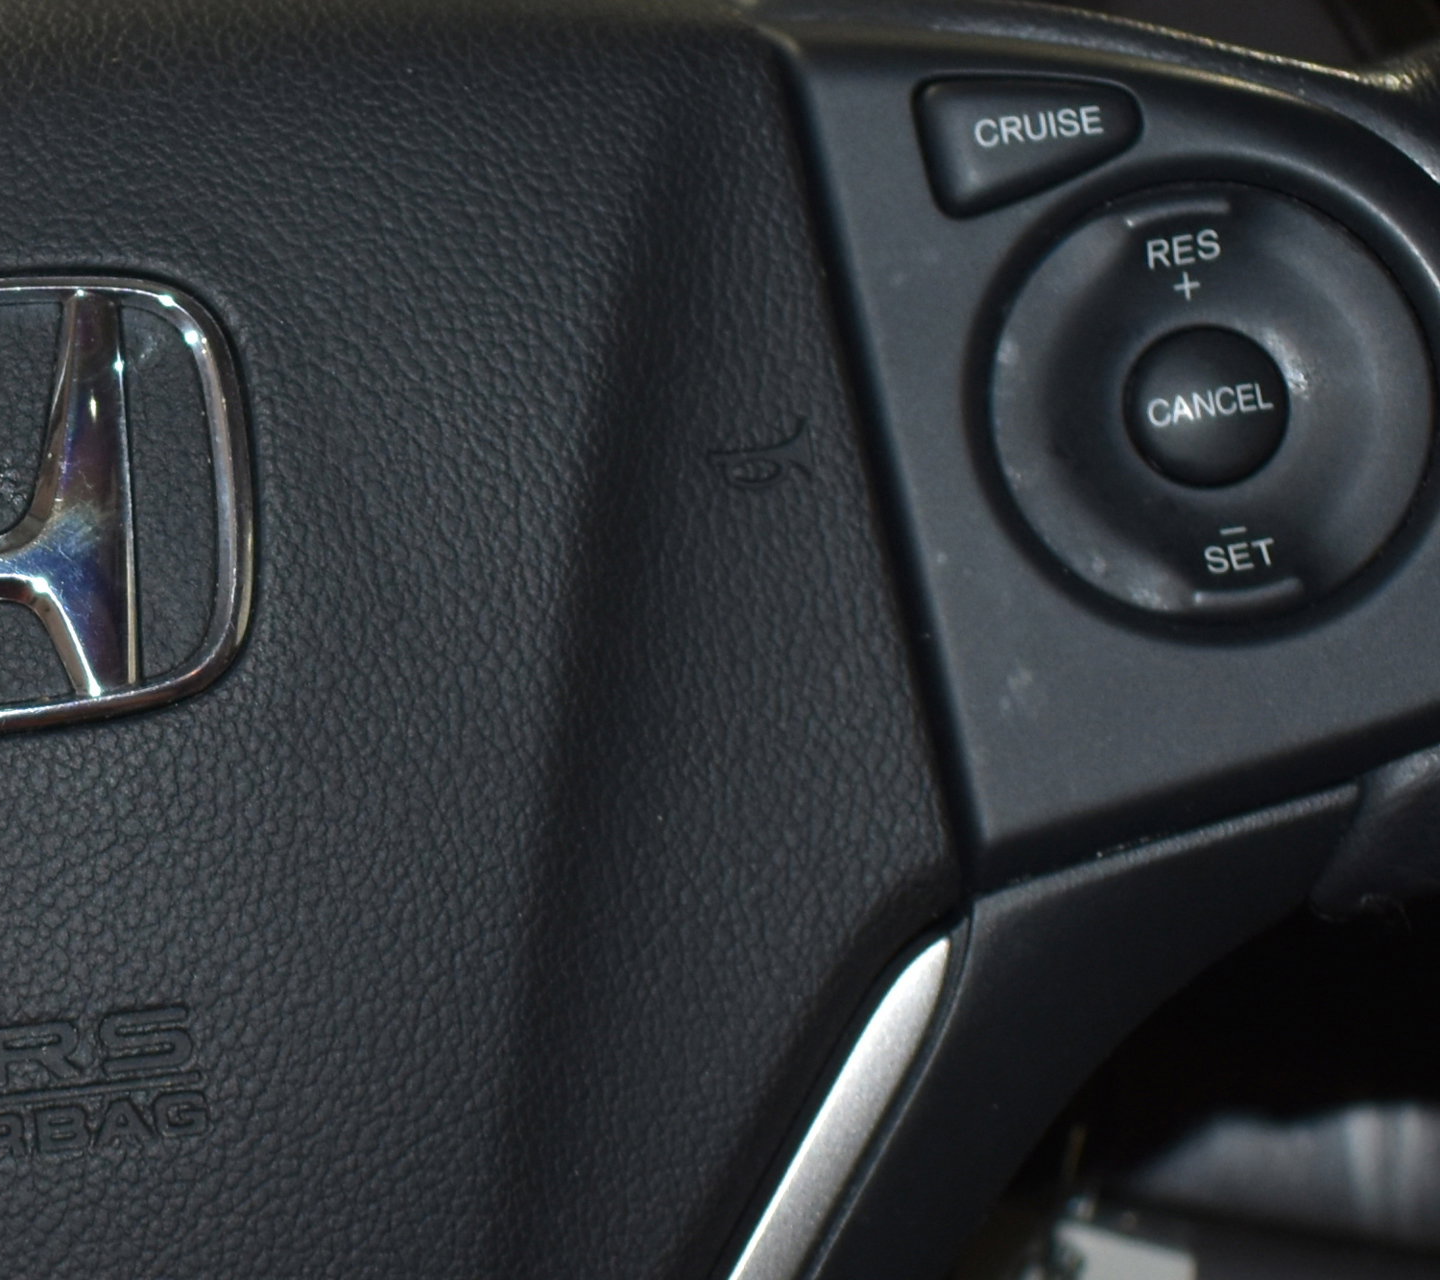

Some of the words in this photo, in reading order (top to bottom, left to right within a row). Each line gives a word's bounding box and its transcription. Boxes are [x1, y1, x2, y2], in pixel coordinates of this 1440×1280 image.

[973, 106, 1104, 148] CRUISE
[1146, 229, 1222, 270] RES
[1146, 382, 1274, 428] CANCEL
[1204, 538, 1275, 575] SET
